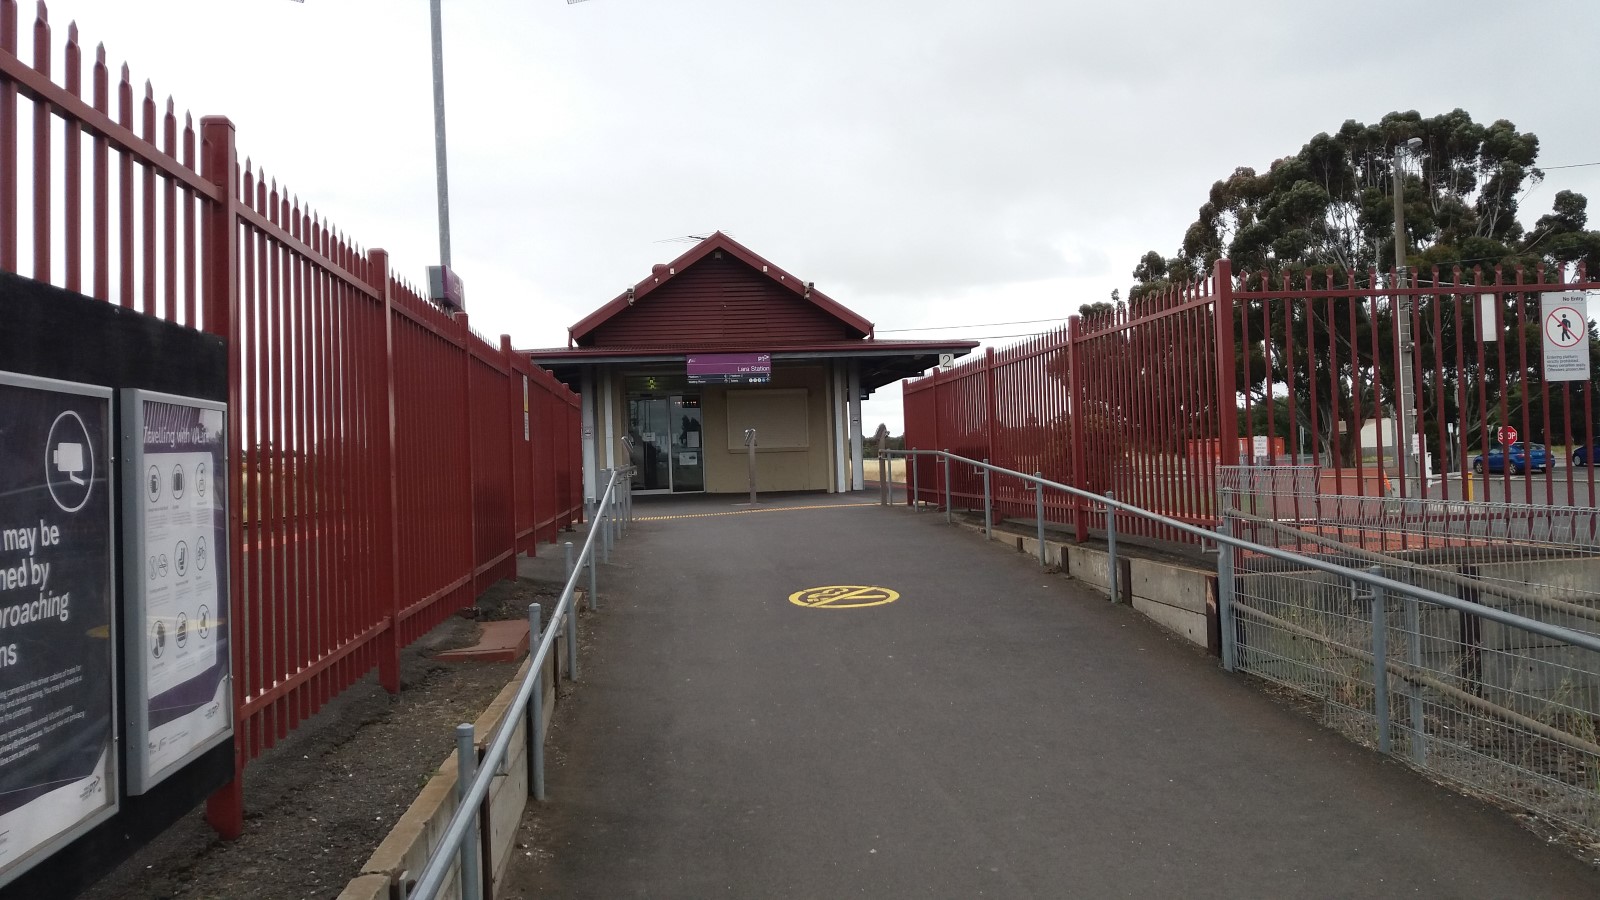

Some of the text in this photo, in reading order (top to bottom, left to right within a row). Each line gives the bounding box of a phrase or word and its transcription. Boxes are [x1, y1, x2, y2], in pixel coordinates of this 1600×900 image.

[942, 354, 951, 367] 2
[1499, 432, 1516, 440] SOP
[3, 519, 59, 556] may be
[30, 557, 49, 591] by
[0, 590, 69, 629] roaching
